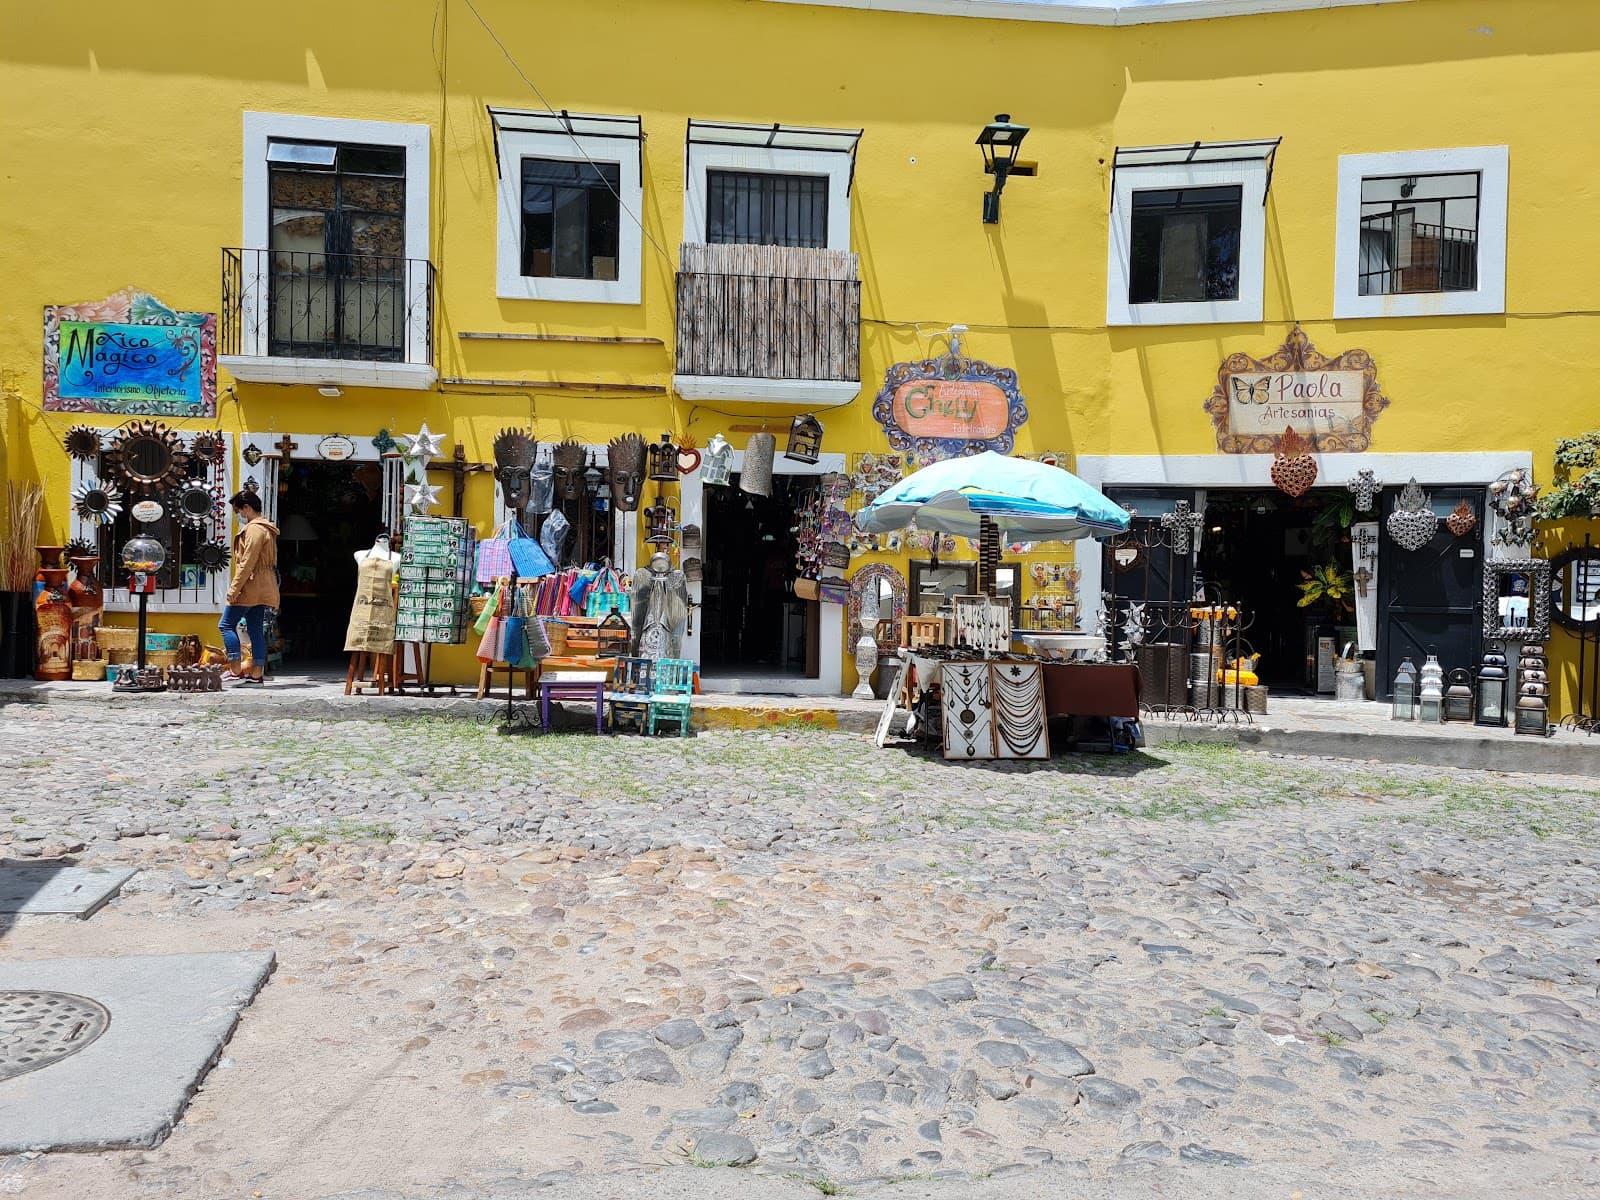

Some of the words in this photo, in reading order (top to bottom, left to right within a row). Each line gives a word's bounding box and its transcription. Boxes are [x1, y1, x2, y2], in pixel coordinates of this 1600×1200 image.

[1274, 373, 1343, 401] Paola
[1263, 405, 1336, 420] Artesanias
[399, 597, 413, 608] DON
